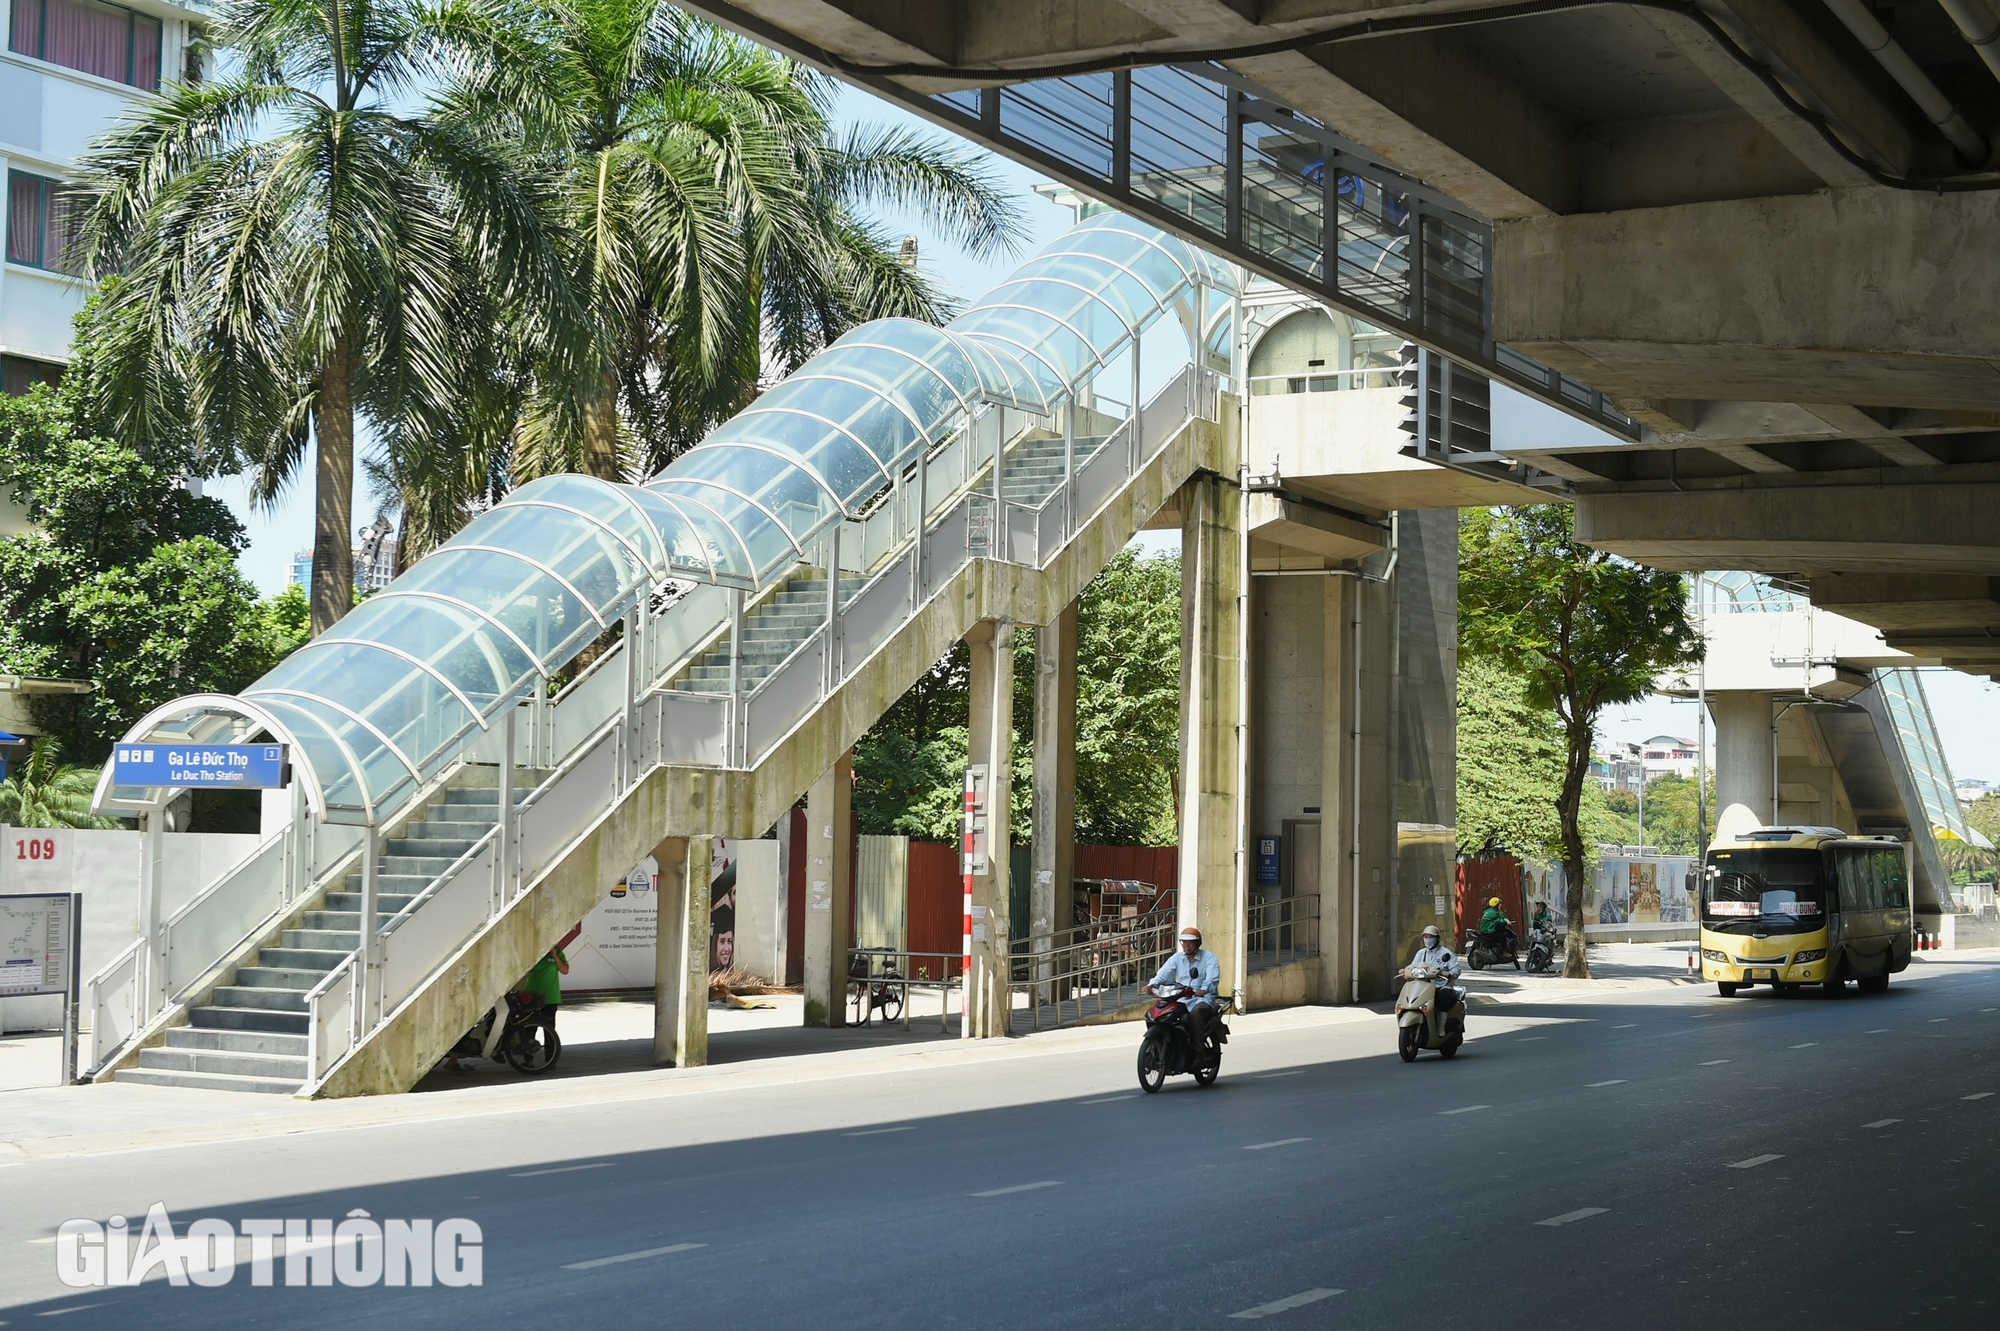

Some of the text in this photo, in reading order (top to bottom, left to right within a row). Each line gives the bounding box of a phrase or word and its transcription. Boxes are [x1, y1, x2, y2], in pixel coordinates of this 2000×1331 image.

[168, 751, 249, 769] Ga Lê Đức Thọ
[269, 750, 275, 758] 3
[171, 770, 244, 781] Le Duc Tho Station
[16, 838, 56, 860] 109
